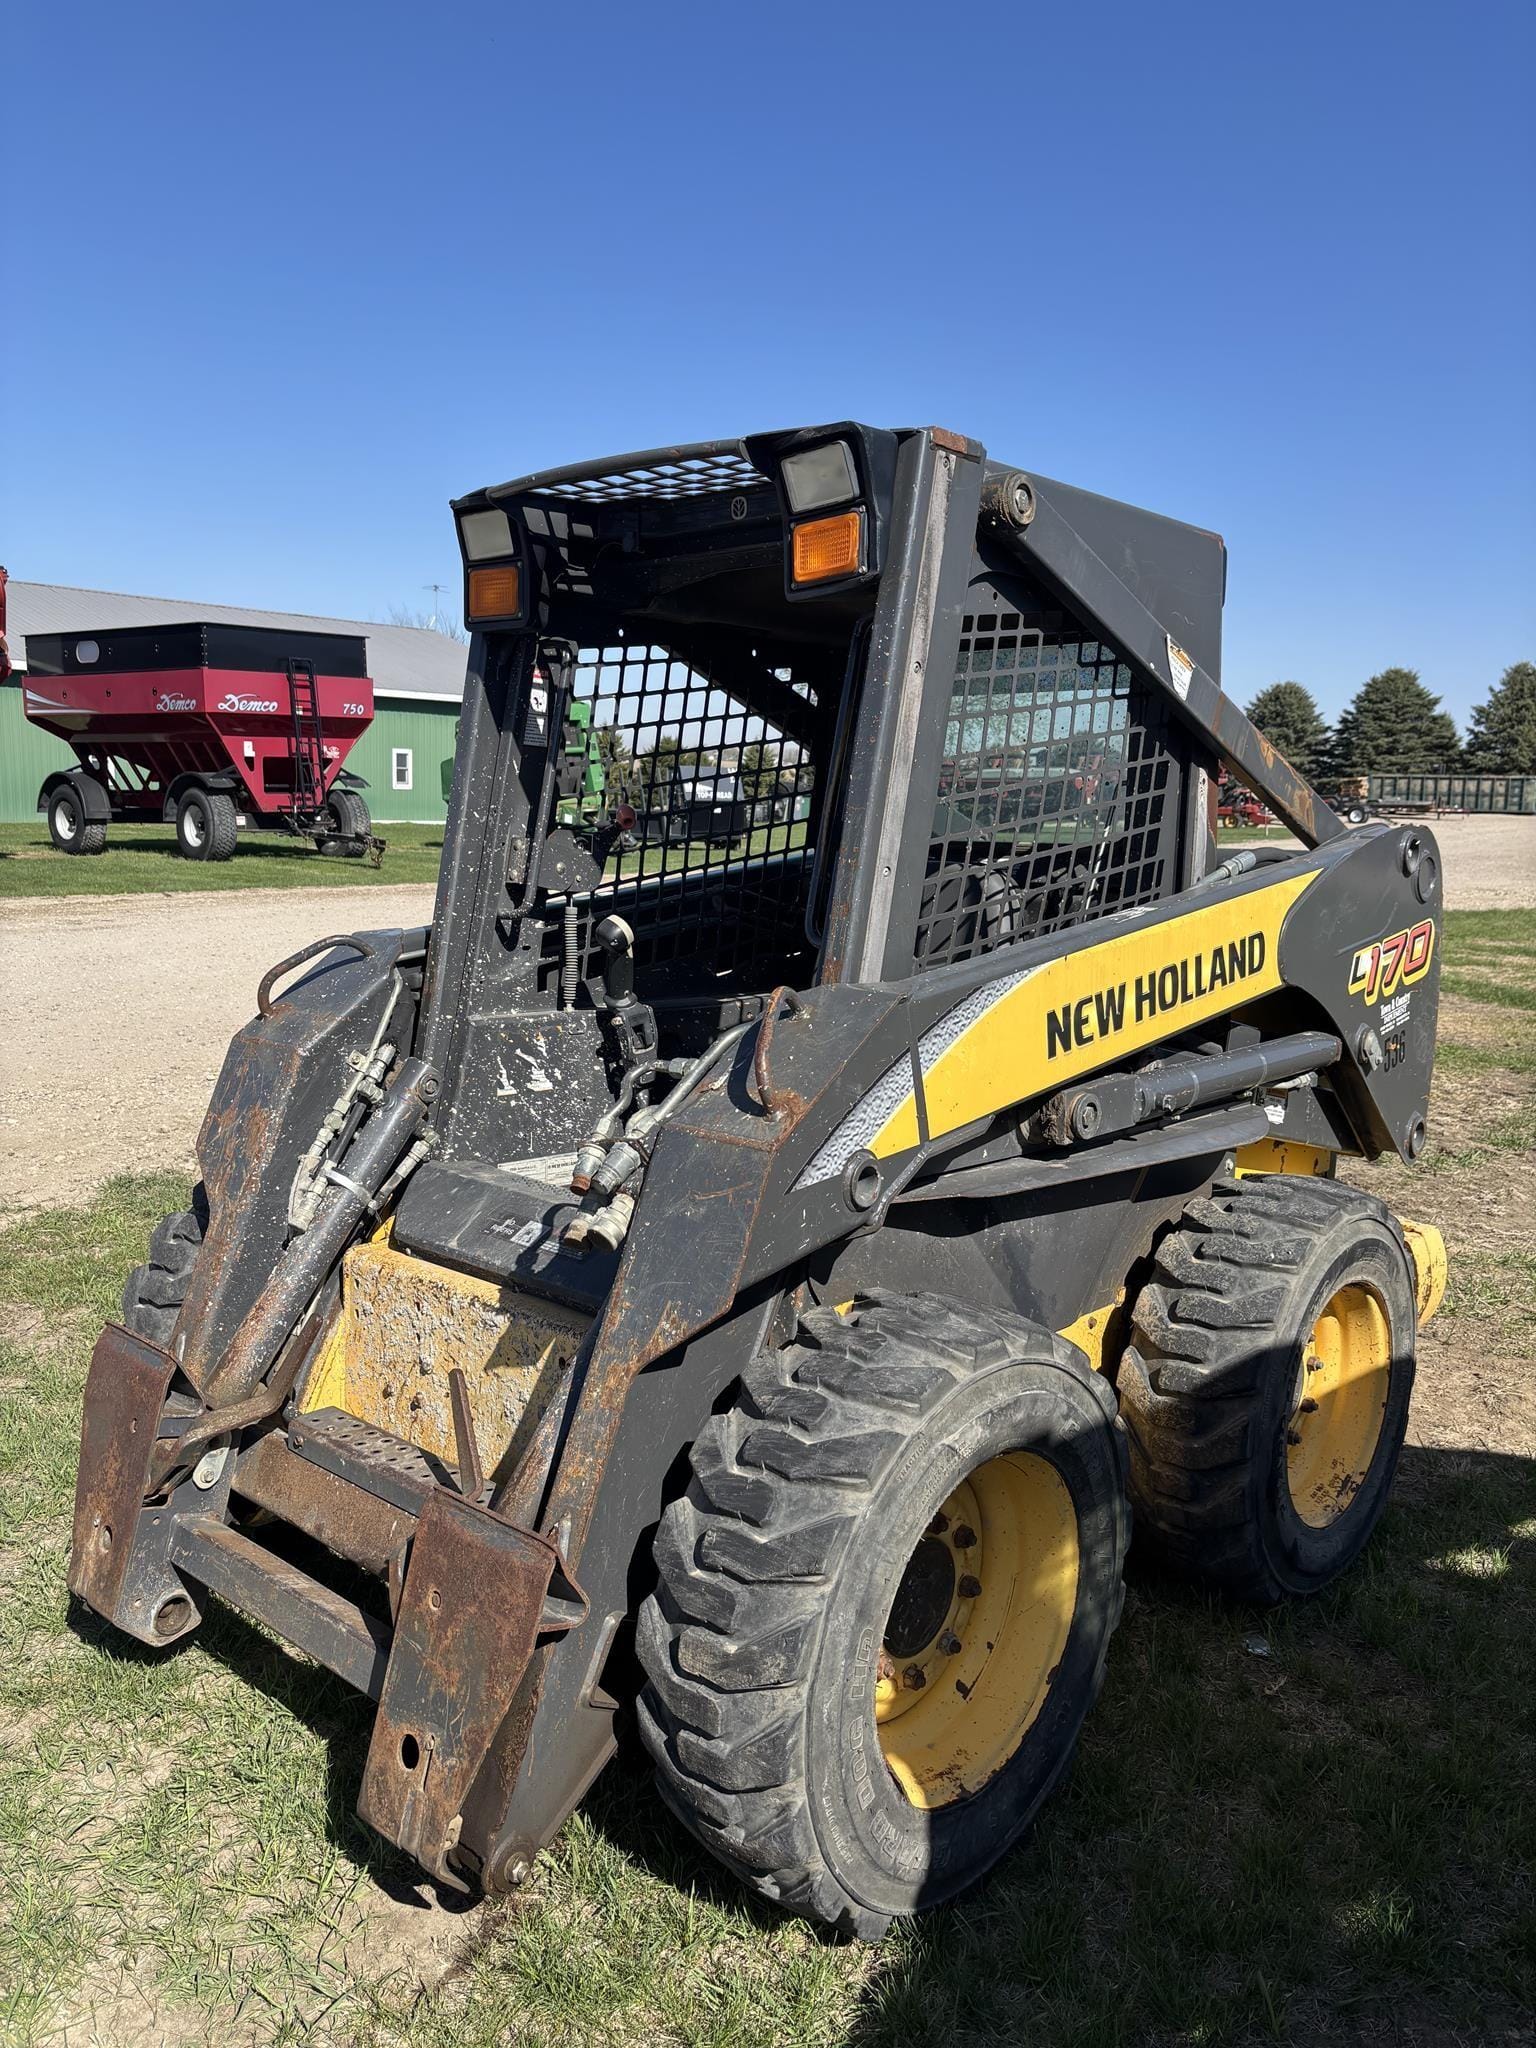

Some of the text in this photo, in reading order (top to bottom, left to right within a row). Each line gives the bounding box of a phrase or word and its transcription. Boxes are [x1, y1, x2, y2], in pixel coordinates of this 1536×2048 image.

[156, 692, 197, 711] Demco
[217, 693, 278, 712] Demco
[343, 703, 364, 716] 750
[1046, 930, 1266, 1061] NEW HOLLAND
[1349, 918, 1435, 1006] L170
[851, 1628, 874, 1699] HD
[850, 1714, 876, 1811] DOG
